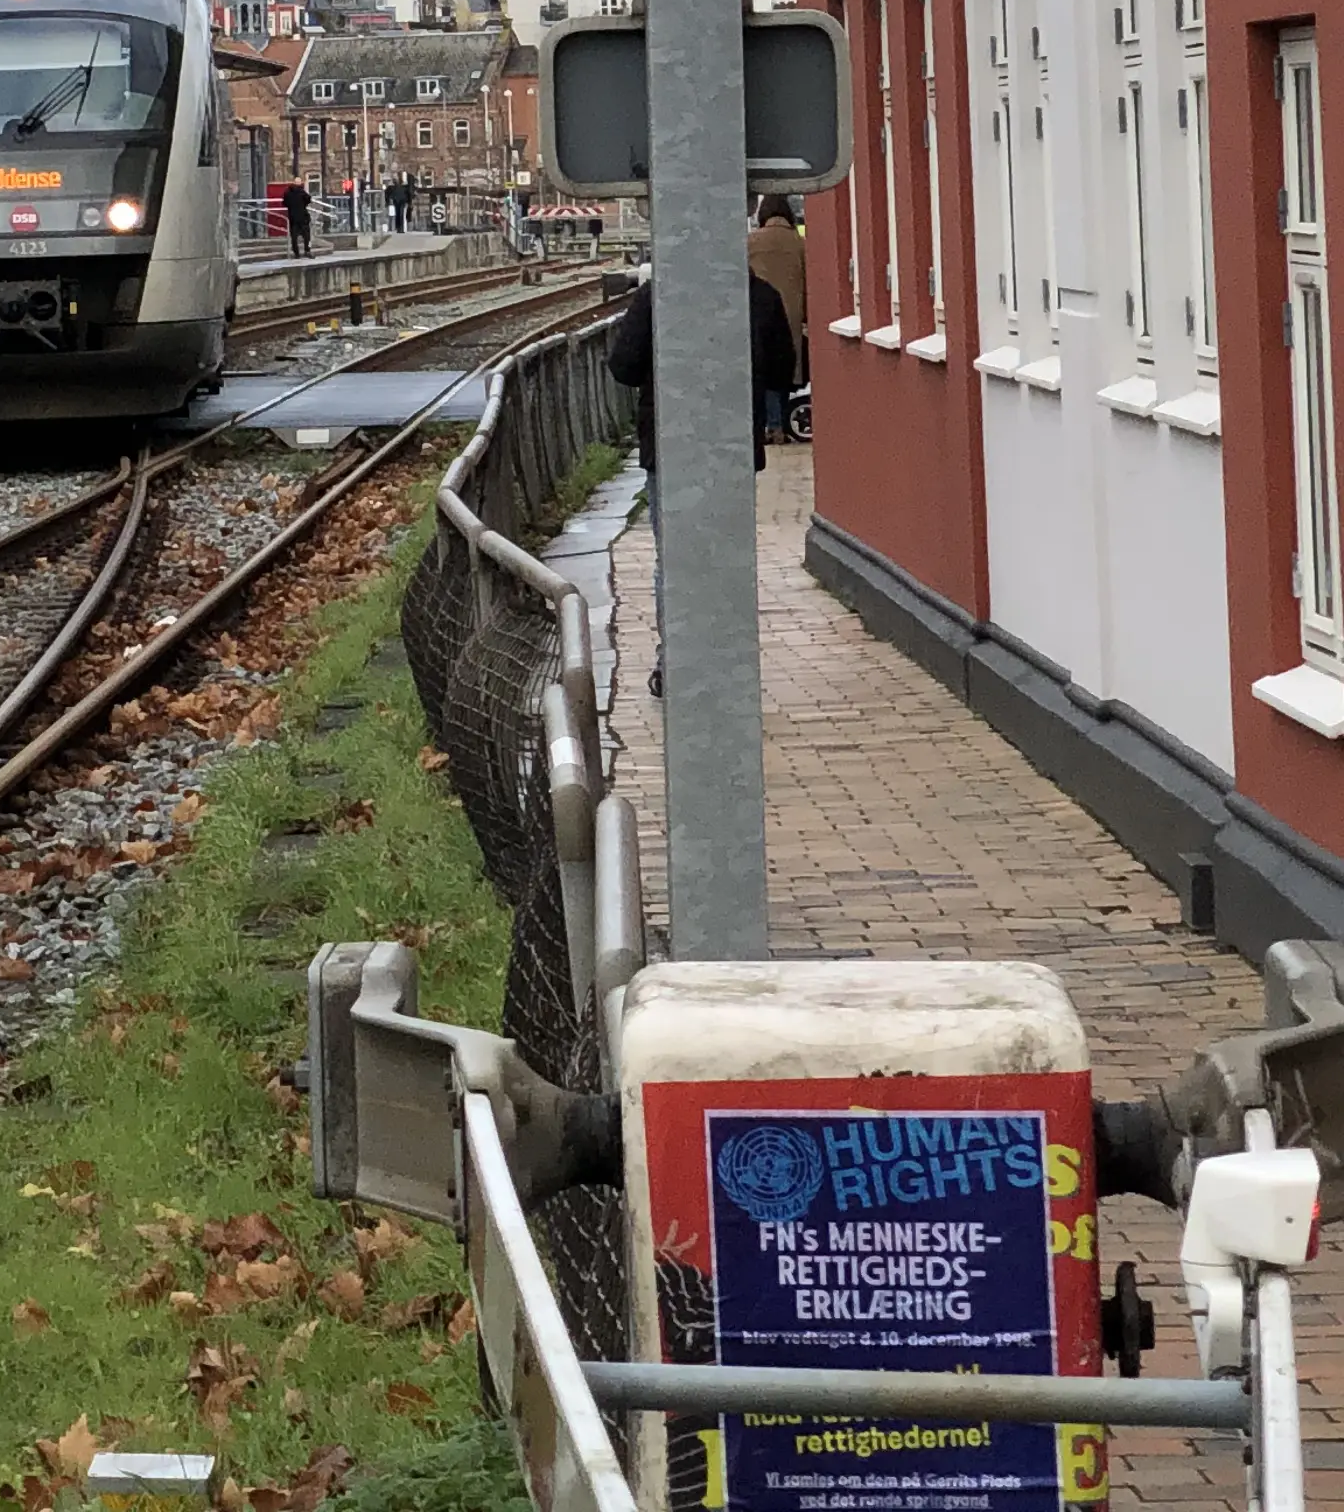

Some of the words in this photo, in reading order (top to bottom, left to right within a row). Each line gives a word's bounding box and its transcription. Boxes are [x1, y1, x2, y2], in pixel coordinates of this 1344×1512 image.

[12, 213, 37, 224] DSB
[433, 205, 444, 220] S
[9, 241, 48, 256] 4123
[822, 1117, 1035, 1168] HUMAN
[831, 1144, 1044, 1212] RIGHTS
[759, 1221, 818, 1252] FN's
[829, 1221, 1003, 1253] MENNESKE-
[778, 1255, 987, 1287] RETTIGHEDS-
[796, 1290, 972, 1321] ERKLÆRING
[742, 1330, 777, 1345] blev
[780, 1330, 856, 1349] vedtaget
[859, 1331, 876, 1346] d.
[879, 1331, 903, 1346] 10.
[907, 1331, 990, 1348] december
[795, 1421, 992, 1457] rettighederne!
[765, 1472, 780, 1487] Vi
[783, 1472, 834, 1488] samles
[838, 1474, 861, 1488] om
[865, 1473, 898, 1488] dem
[901, 1471, 920, 1490] på
[924, 1472, 977, 1488] Gerrits
[980, 1473, 1022, 1489] Plads
[799, 1493, 826, 1508] ved
[830, 1492, 856, 1507] det
[859, 1493, 903, 1508] runde
